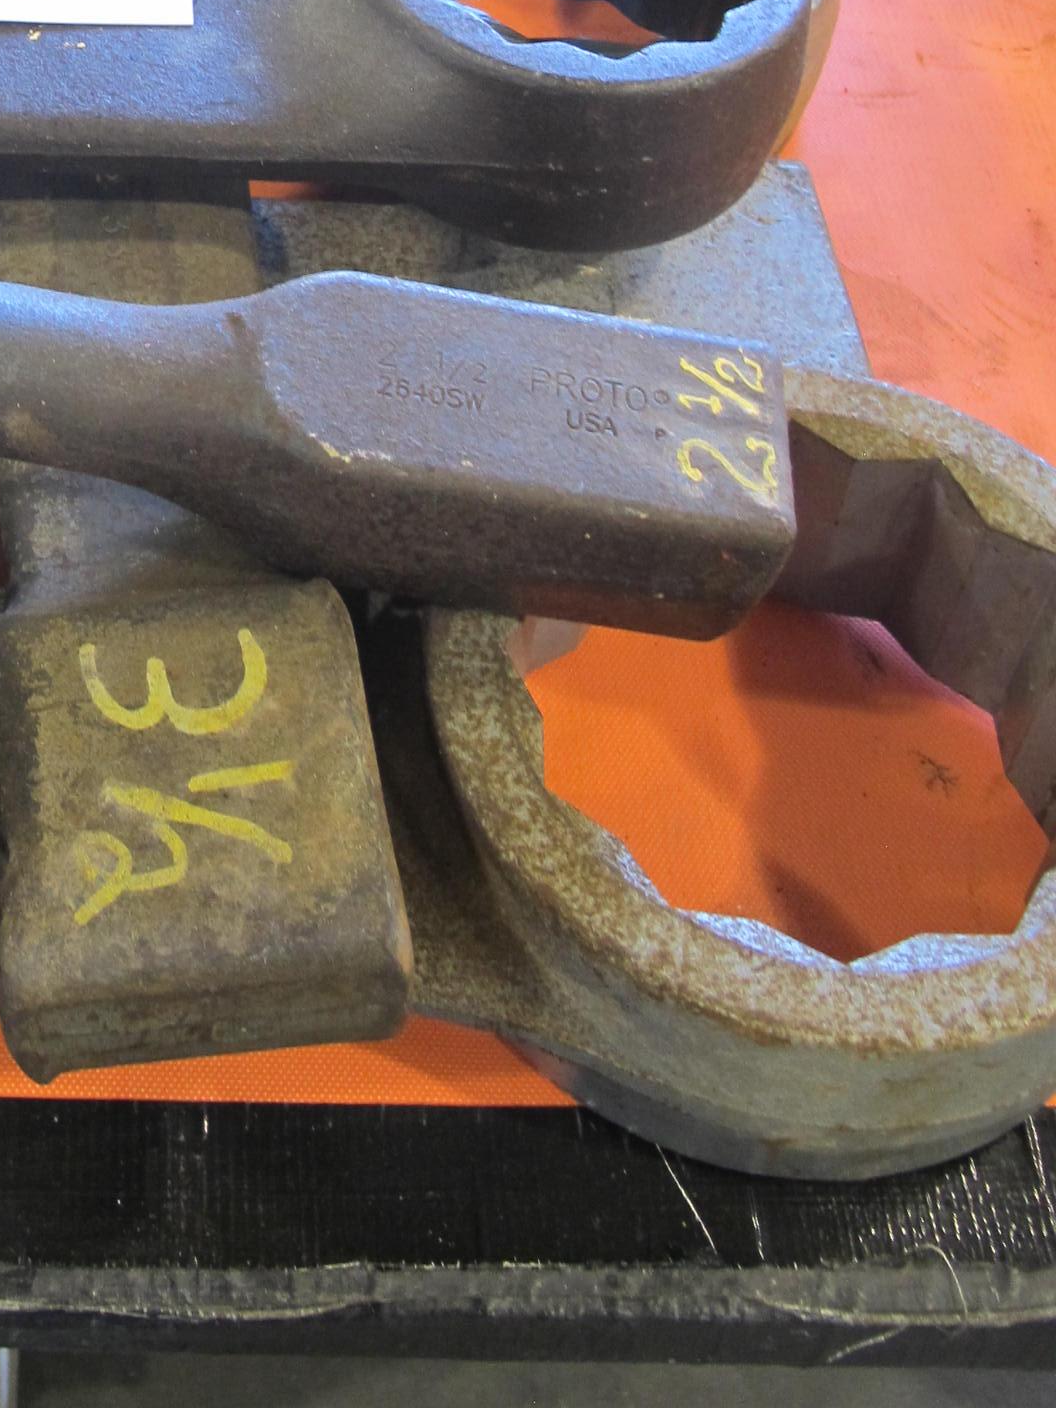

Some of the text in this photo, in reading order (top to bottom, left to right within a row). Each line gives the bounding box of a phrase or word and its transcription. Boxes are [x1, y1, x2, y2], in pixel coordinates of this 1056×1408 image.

[565, 408, 619, 439] USA
[675, 436, 778, 497] 2
[78, 627, 269, 736] 3
